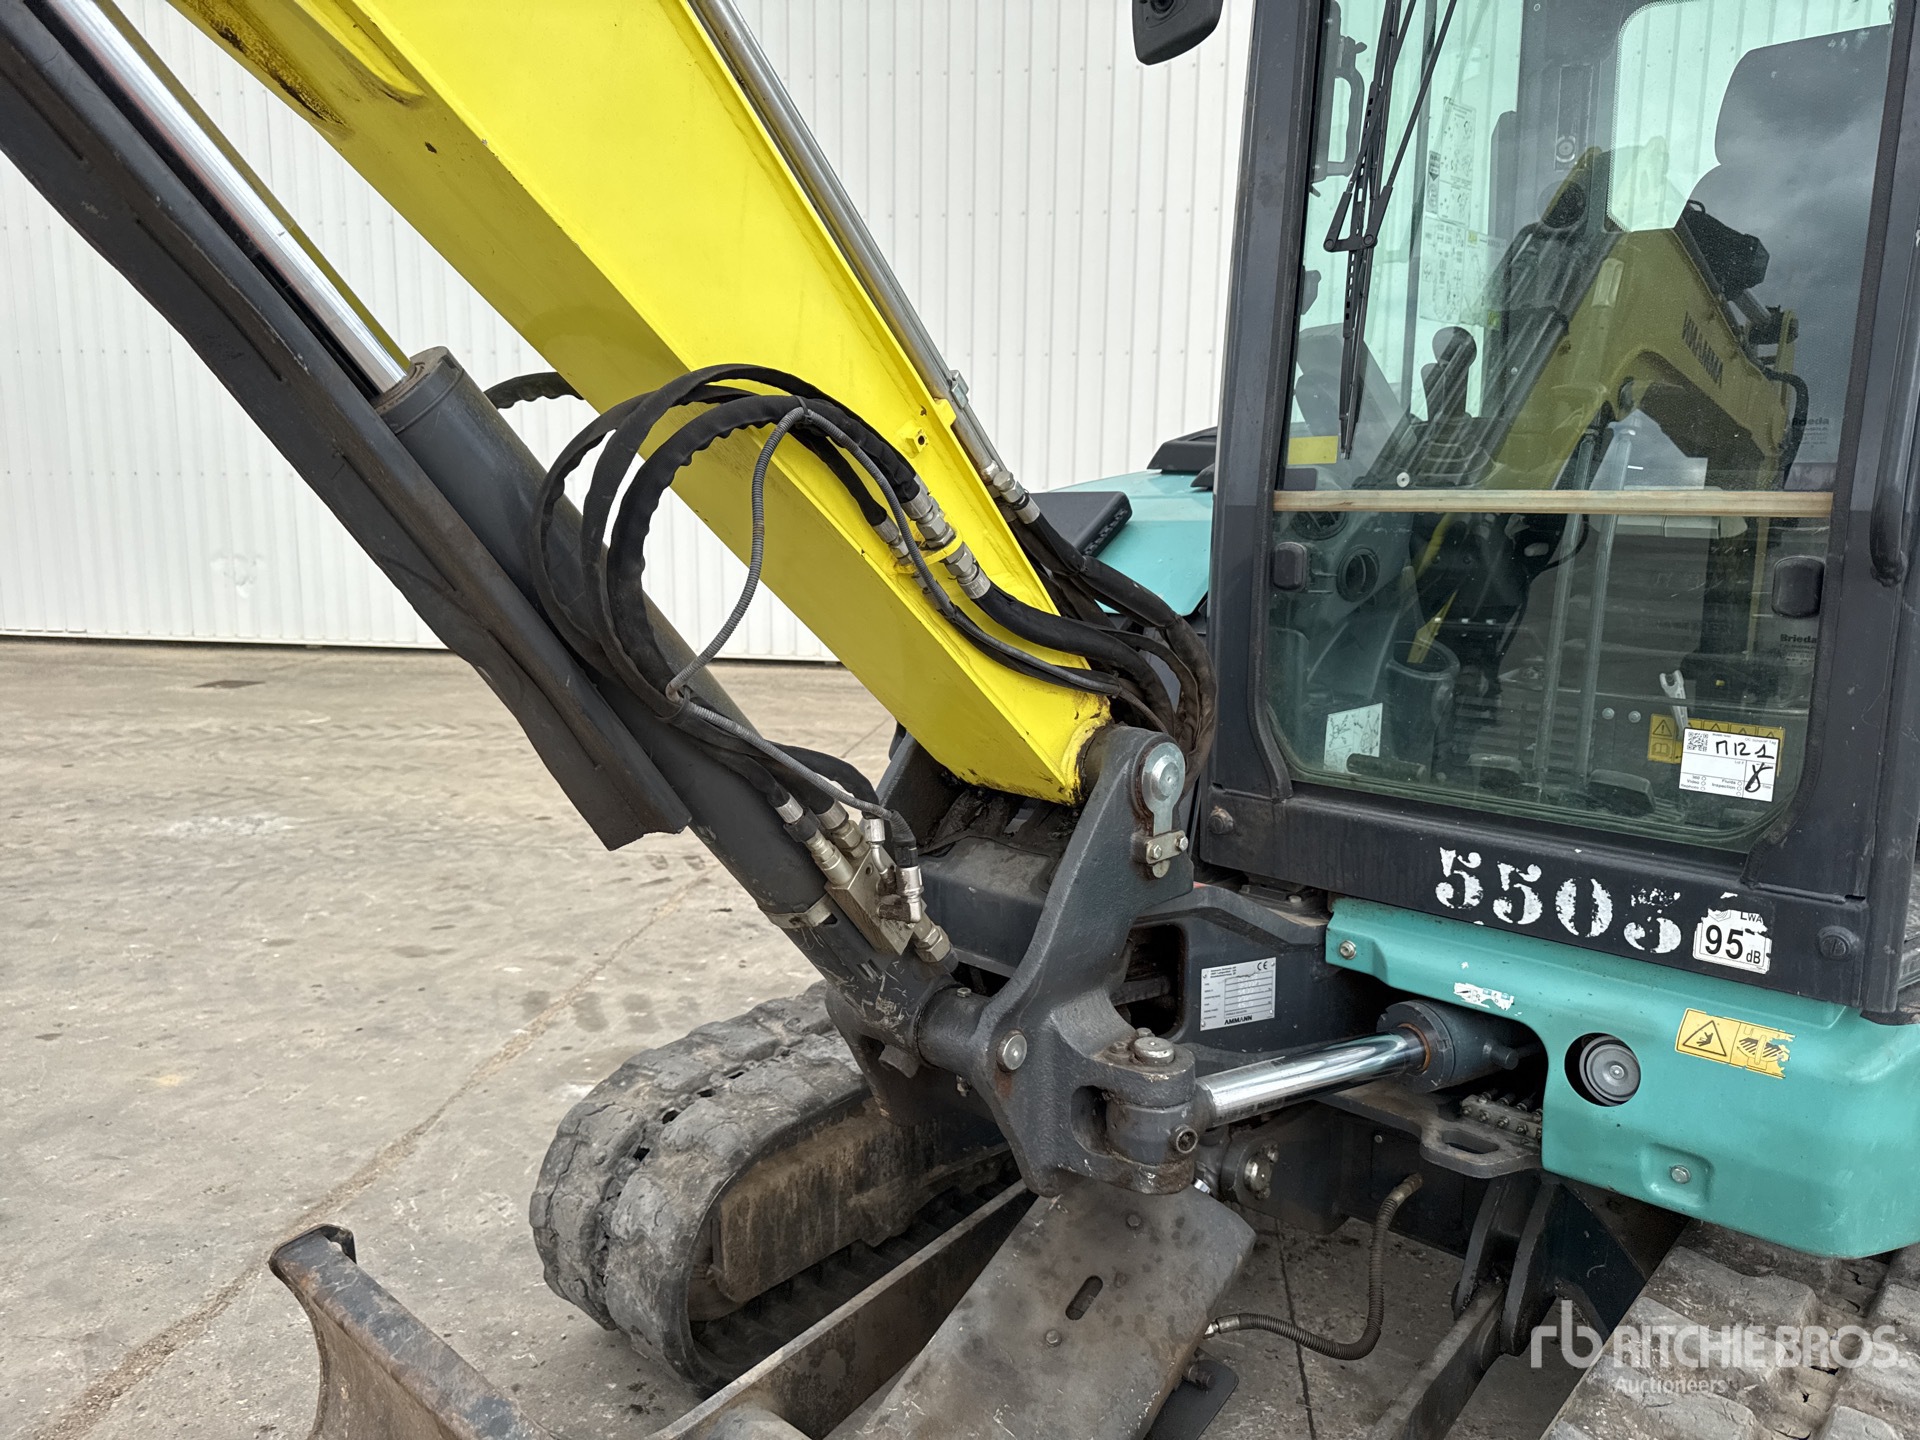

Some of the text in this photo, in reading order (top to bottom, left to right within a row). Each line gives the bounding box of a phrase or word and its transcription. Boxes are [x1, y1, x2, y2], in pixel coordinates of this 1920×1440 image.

[1780, 633, 1817, 644] Brieda
[1705, 924, 1761, 965] 95 dB
[1224, 1015, 1252, 1025] AMMANN
